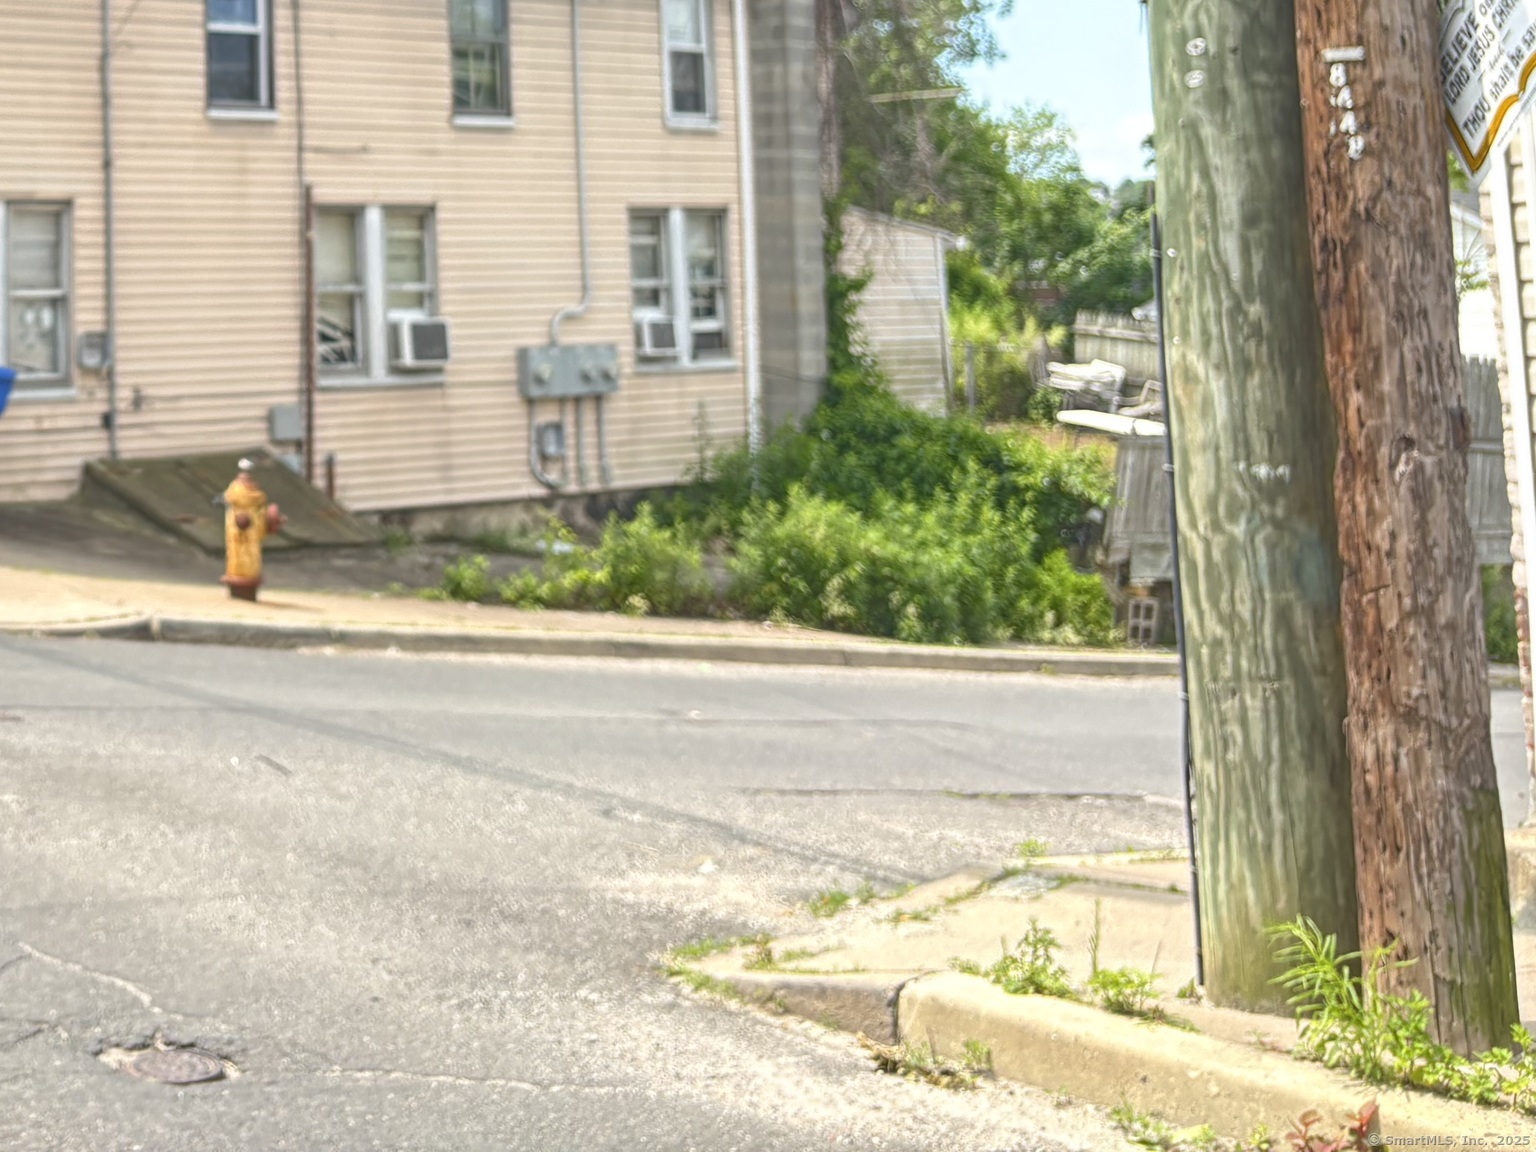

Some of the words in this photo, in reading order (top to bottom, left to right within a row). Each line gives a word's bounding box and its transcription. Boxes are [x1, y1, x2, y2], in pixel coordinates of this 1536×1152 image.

[1444, 64, 1470, 105] LORD
[1467, 24, 1496, 70] JESUS
[1462, 94, 1491, 138] THOU
[1507, 44, 1524, 69] be
